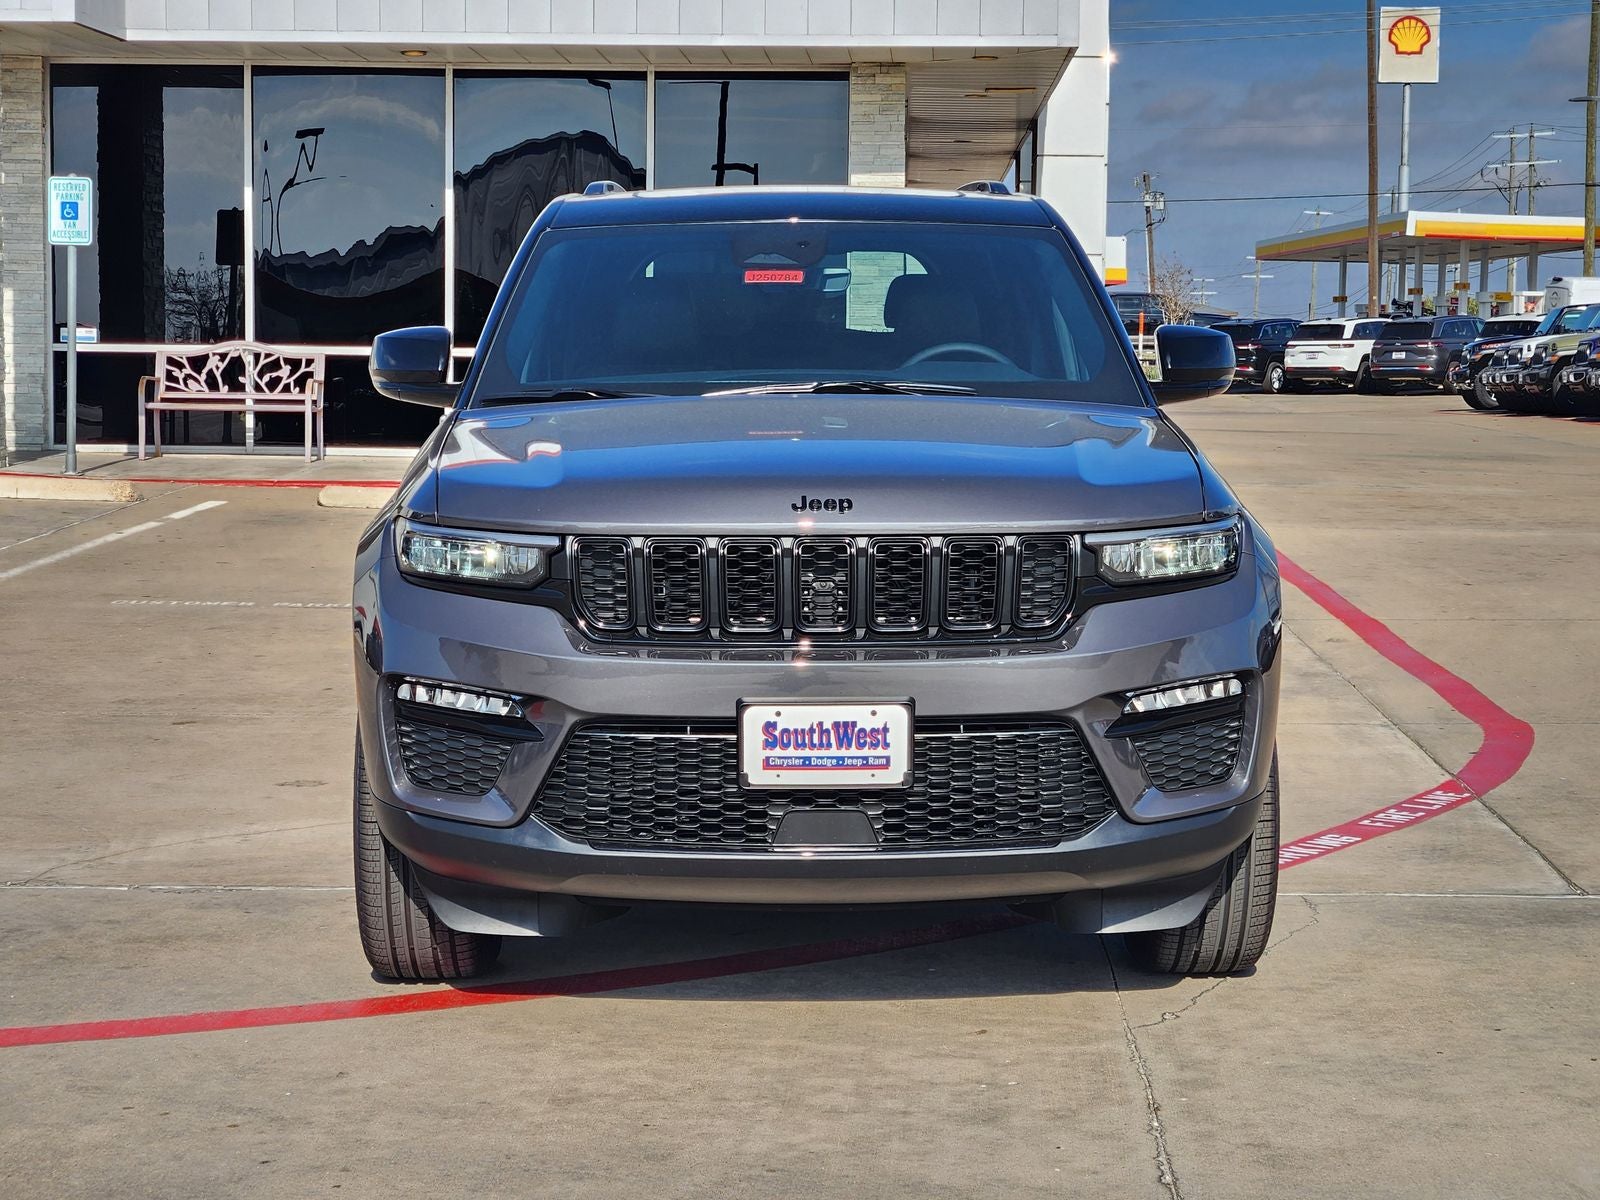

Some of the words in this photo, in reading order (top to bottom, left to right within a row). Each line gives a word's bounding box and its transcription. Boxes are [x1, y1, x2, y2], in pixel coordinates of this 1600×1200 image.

[53, 183, 87, 191] RESERVED
[55, 192, 84, 201] PARKING
[63, 221, 77, 229] VAN
[52, 230, 88, 239] ACCESSIBLE
[748, 273, 799, 281] J250784
[791, 495, 853, 514] Jeep
[762, 720, 891, 750] SouthWest
[769, 757, 803, 767] Chrysler
[811, 757, 837, 767] Dodge
[843, 757, 863, 767] Jeep
[869, 757, 887, 766] Ram
[1358, 809, 1426, 828] FIRE
[1402, 790, 1472, 810] LANE
